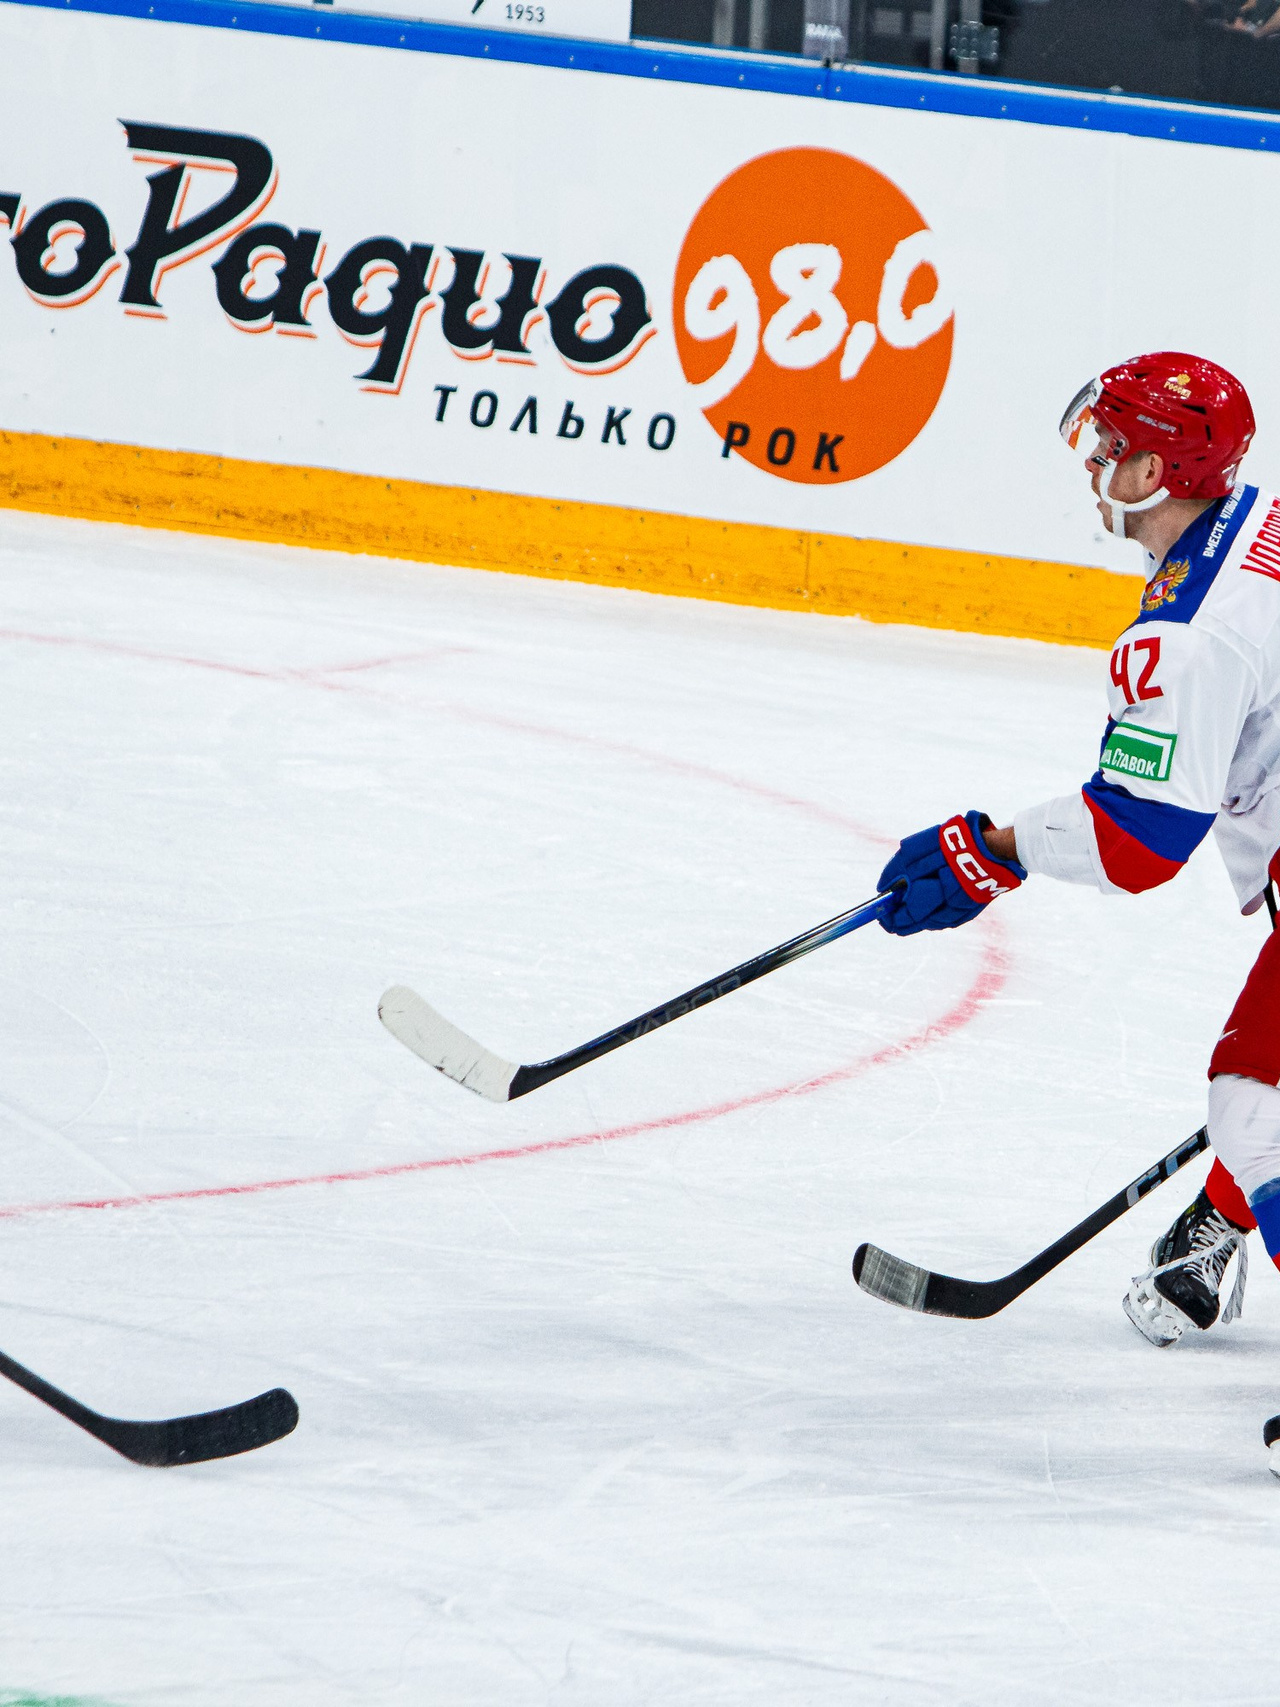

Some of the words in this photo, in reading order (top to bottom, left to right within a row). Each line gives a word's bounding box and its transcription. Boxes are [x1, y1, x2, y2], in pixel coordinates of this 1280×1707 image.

[506, 3, 545, 23] 1953
[433, 383, 677, 452] ТОЛЬКО
[721, 420, 845, 473] РОК
[1110, 636, 1164, 706] 42
[942, 824, 1011, 898] CCM
[1126, 1128, 1210, 1208] CC
